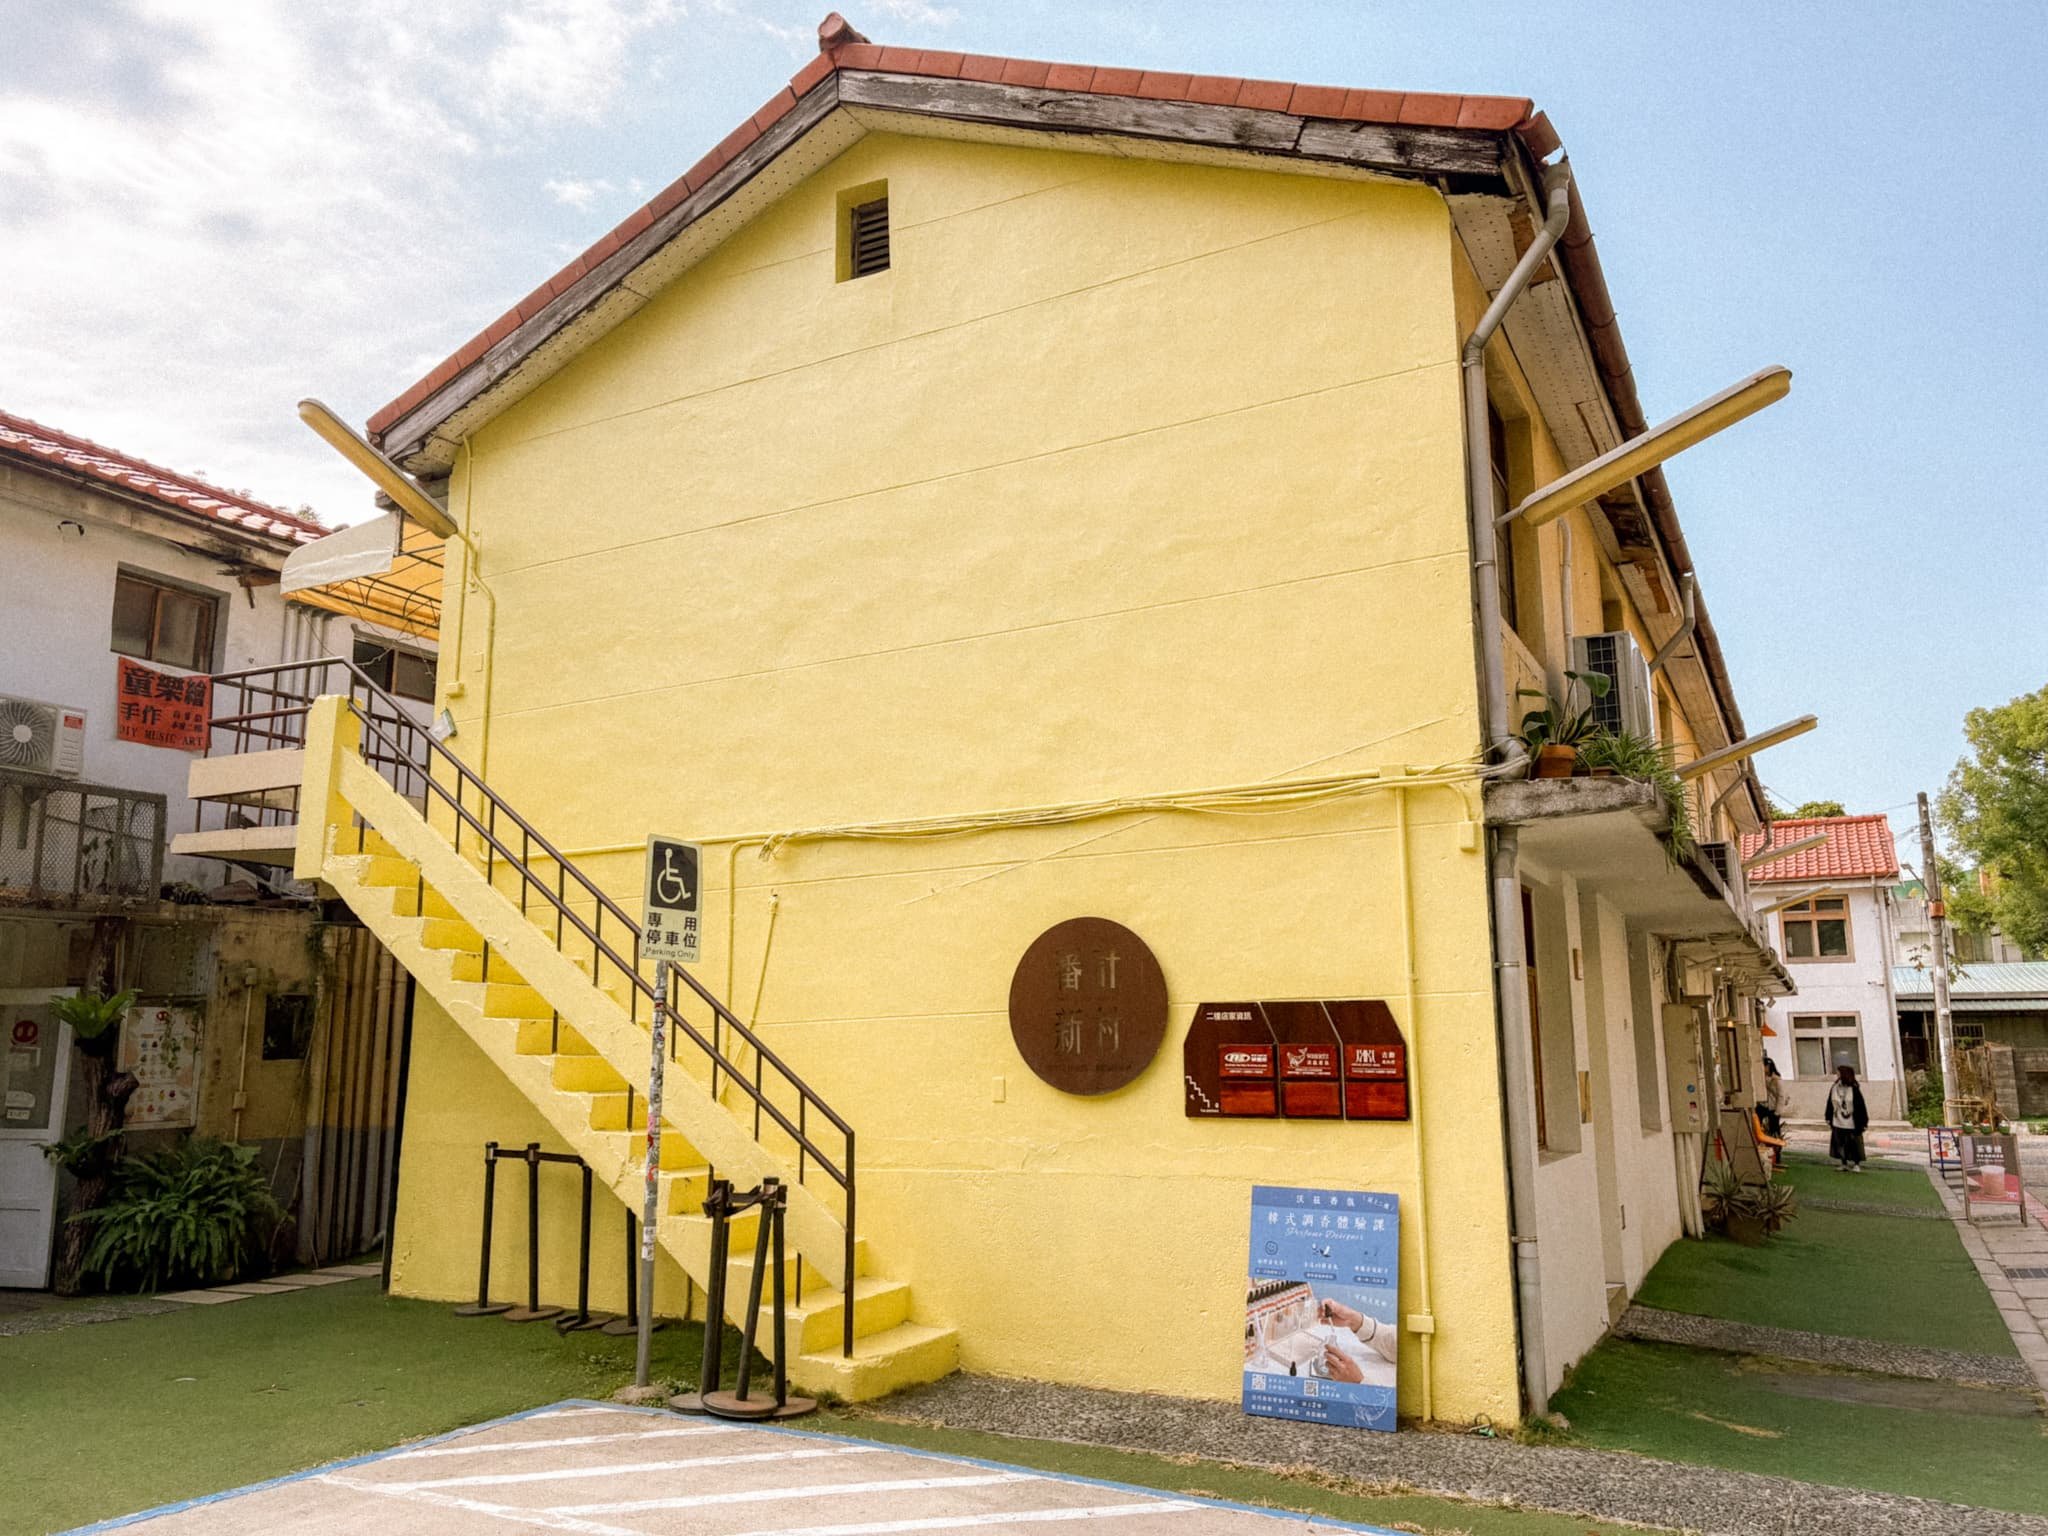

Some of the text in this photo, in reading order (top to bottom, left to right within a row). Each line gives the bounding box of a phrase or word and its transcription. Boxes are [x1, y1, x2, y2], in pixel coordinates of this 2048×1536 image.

[122, 666, 207, 707] 童樂繪
[120, 701, 162, 726] 手作
[144, 729, 177, 744] MUSIC
[182, 736, 204, 746] ART
[647, 912, 697, 932] 專用
[646, 929, 697, 948] 停車位
[645, 946, 696, 960] Parking Only
